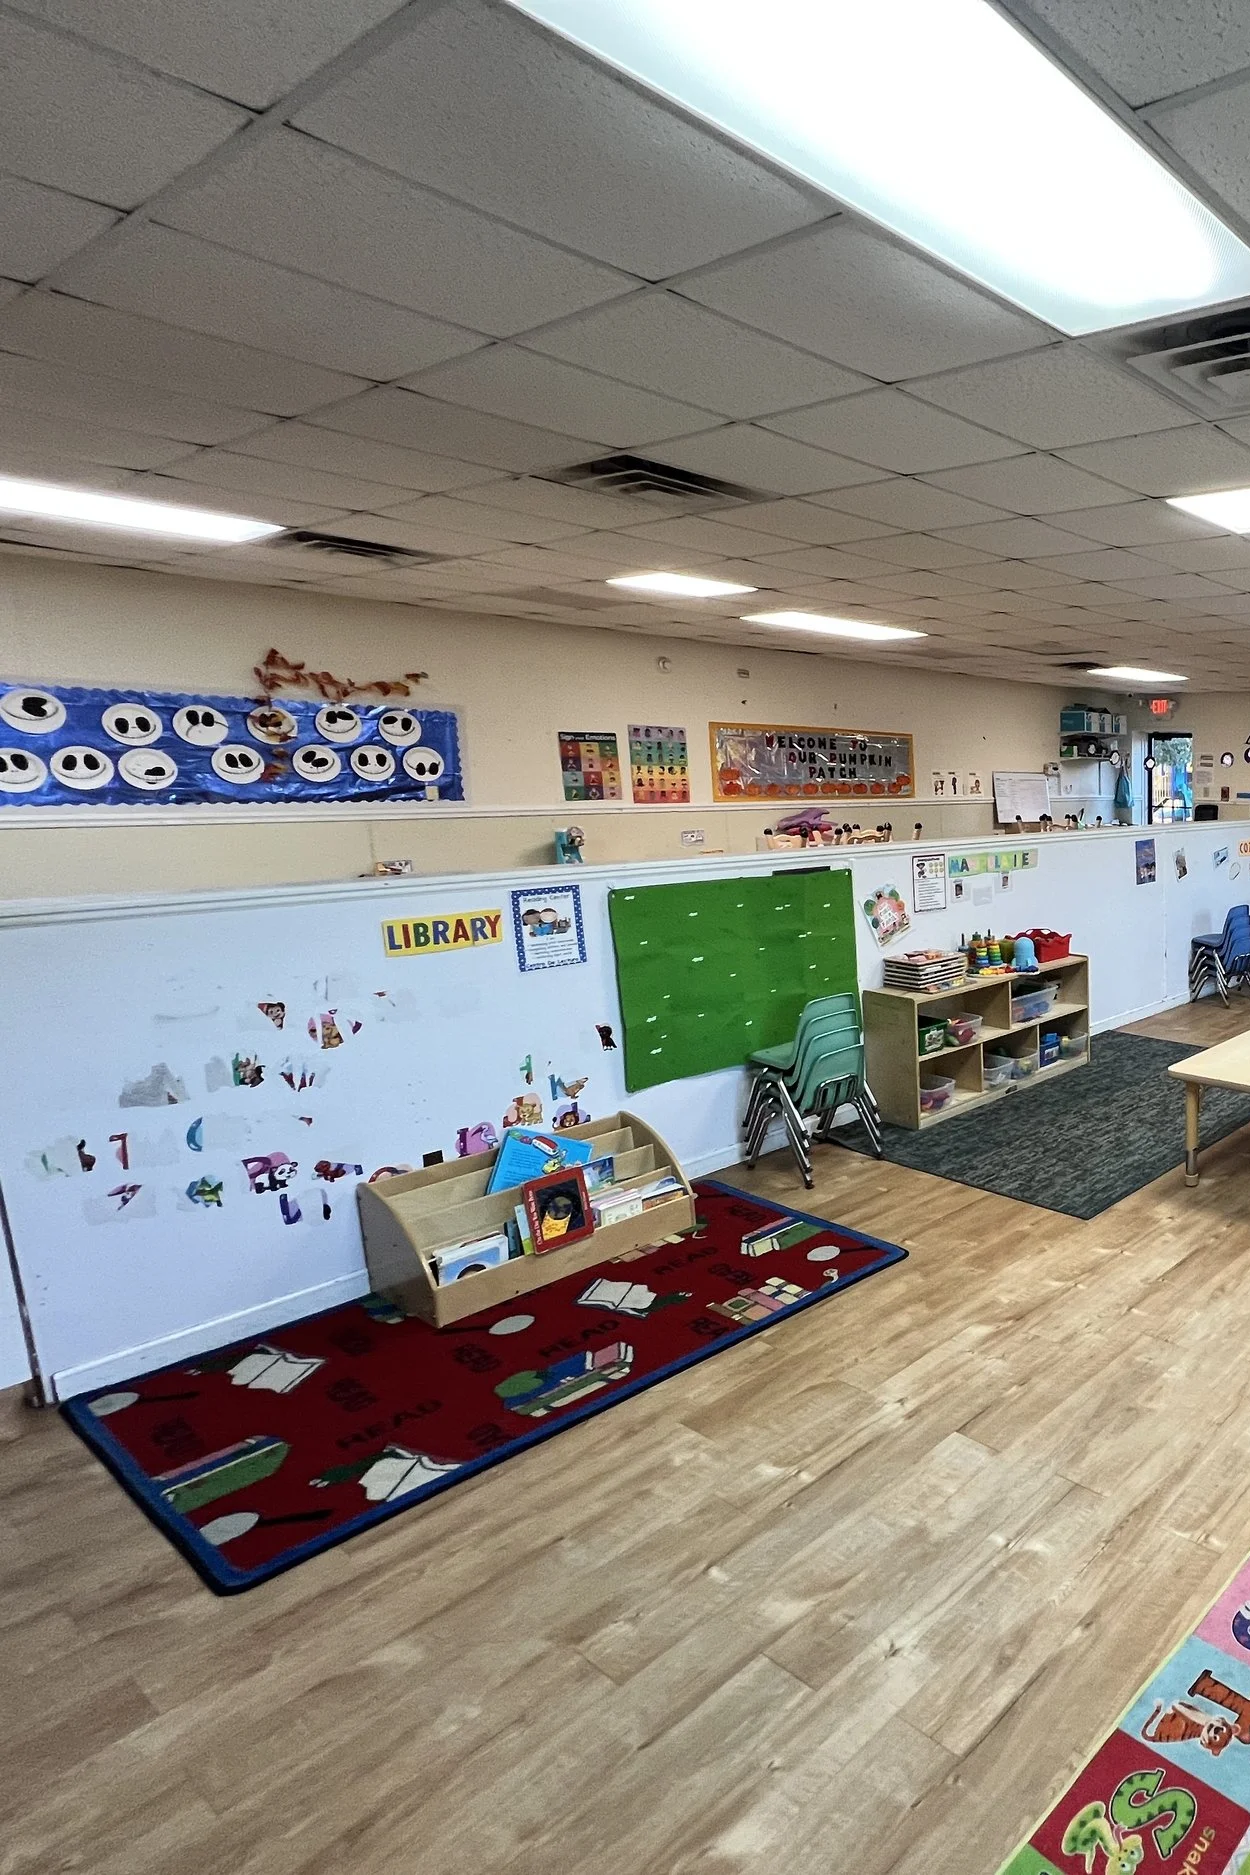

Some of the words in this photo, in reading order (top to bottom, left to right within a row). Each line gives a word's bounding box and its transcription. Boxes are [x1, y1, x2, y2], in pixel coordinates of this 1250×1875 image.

[1152, 699, 1168, 714] EXIT
[585, 733, 616, 741] Emotions
[765, 732, 837, 750] WELCOME
[849, 739, 868, 752] TO
[787, 751, 818, 765] OUR
[829, 753, 893, 768] PUMPKIN
[808, 766, 858, 780] PATCH
[549, 893, 570, 901] Center
[386, 914, 501, 951] LIBRARY
[653, 1245, 719, 1277] READ
[539, 1318, 621, 1358] READ
[336, 1398, 443, 1449] READ
[1110, 1768, 1198, 1860] S
